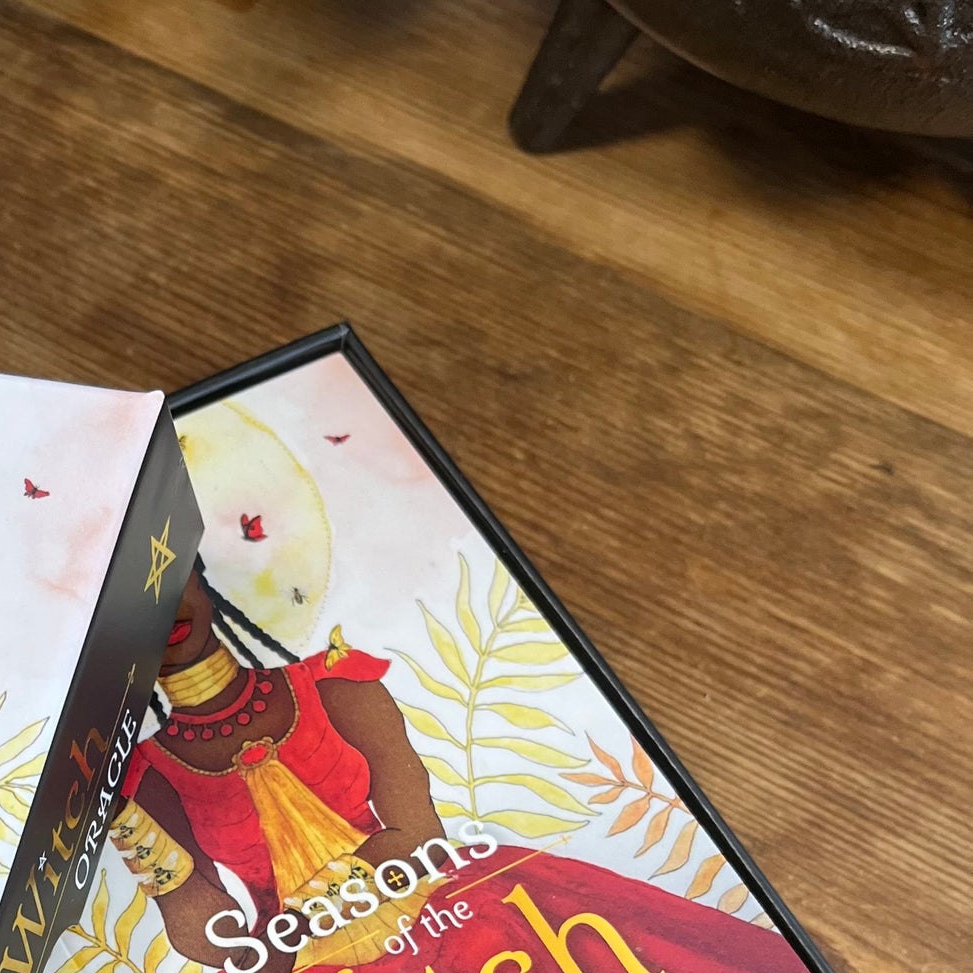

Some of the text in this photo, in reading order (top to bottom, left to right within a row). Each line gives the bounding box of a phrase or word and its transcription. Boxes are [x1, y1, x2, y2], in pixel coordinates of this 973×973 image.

[74, 709, 137, 890] ORACLE
[384, 900, 474, 956] of the
